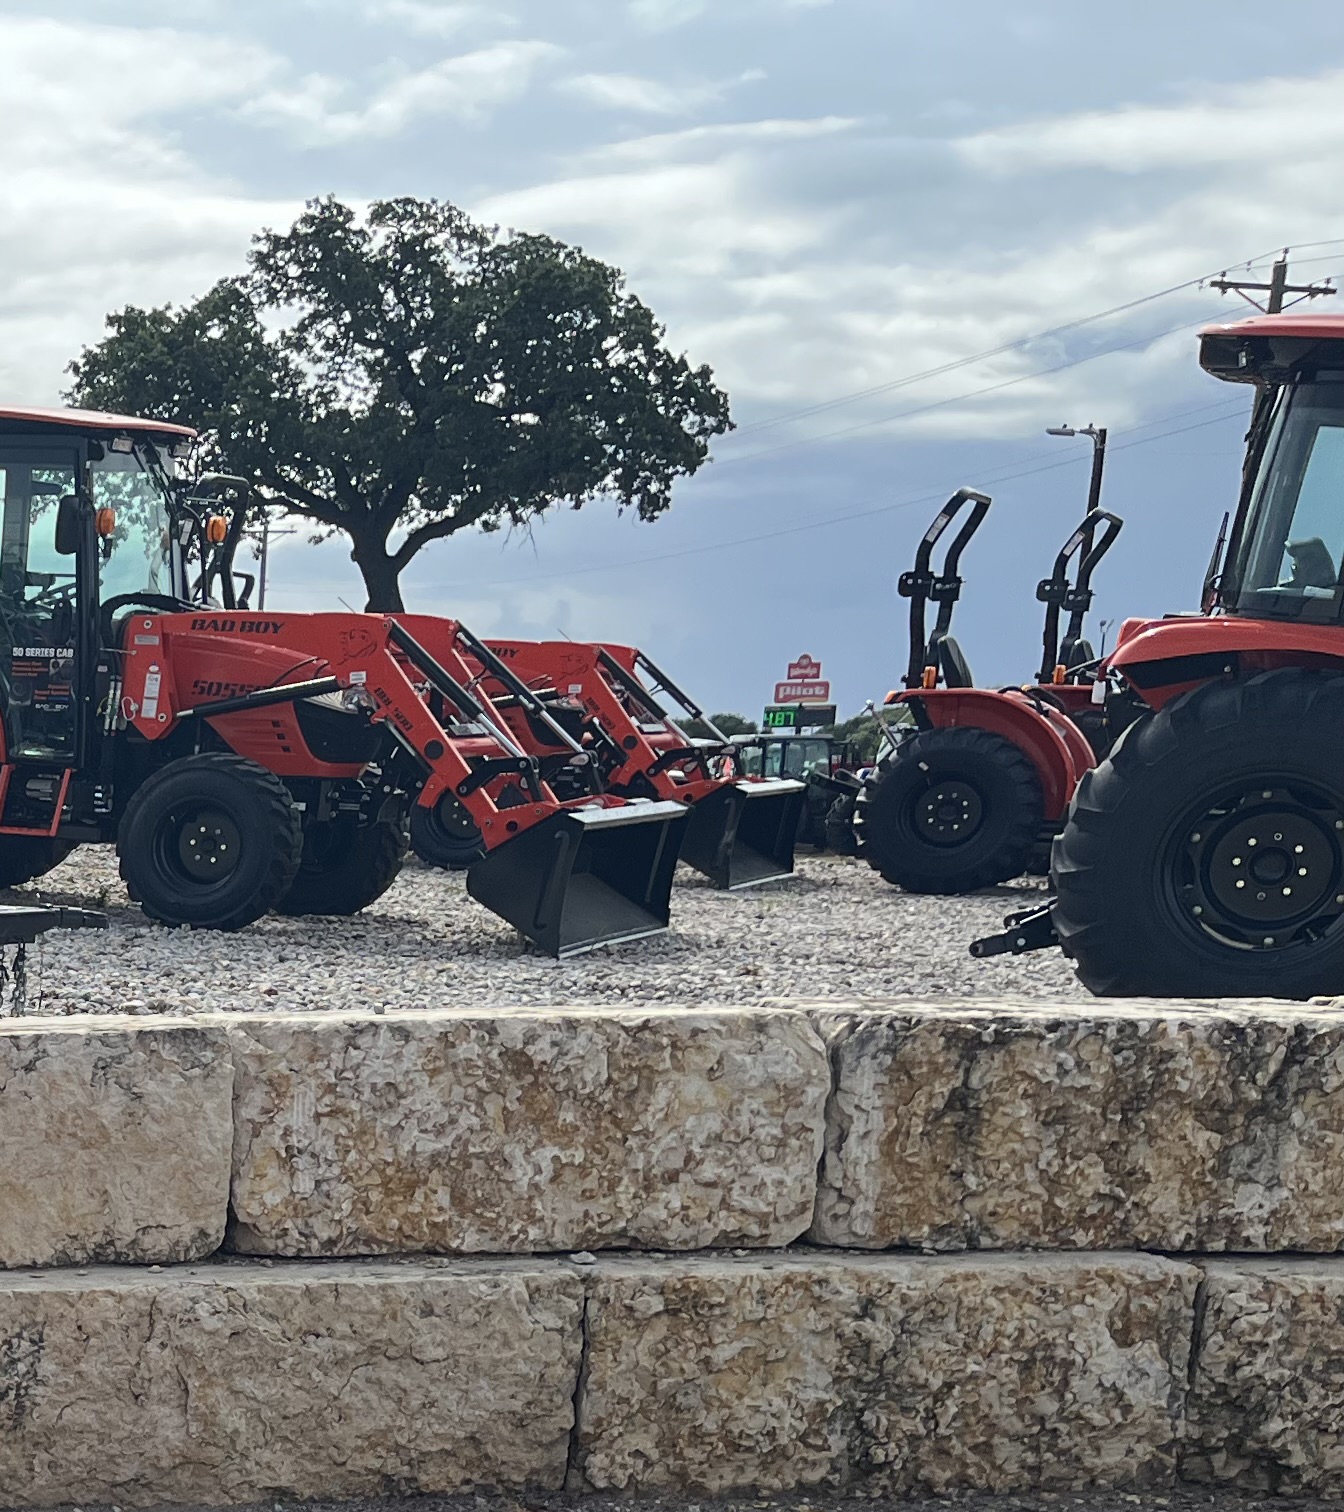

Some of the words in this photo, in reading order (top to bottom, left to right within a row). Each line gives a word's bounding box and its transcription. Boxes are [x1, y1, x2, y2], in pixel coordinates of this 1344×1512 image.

[191, 619, 236, 633] BAD
[239, 620, 286, 634] BOY
[12, 647, 24, 657] 50
[25, 647, 55, 658] SERIES
[56, 648, 74, 658] CAB
